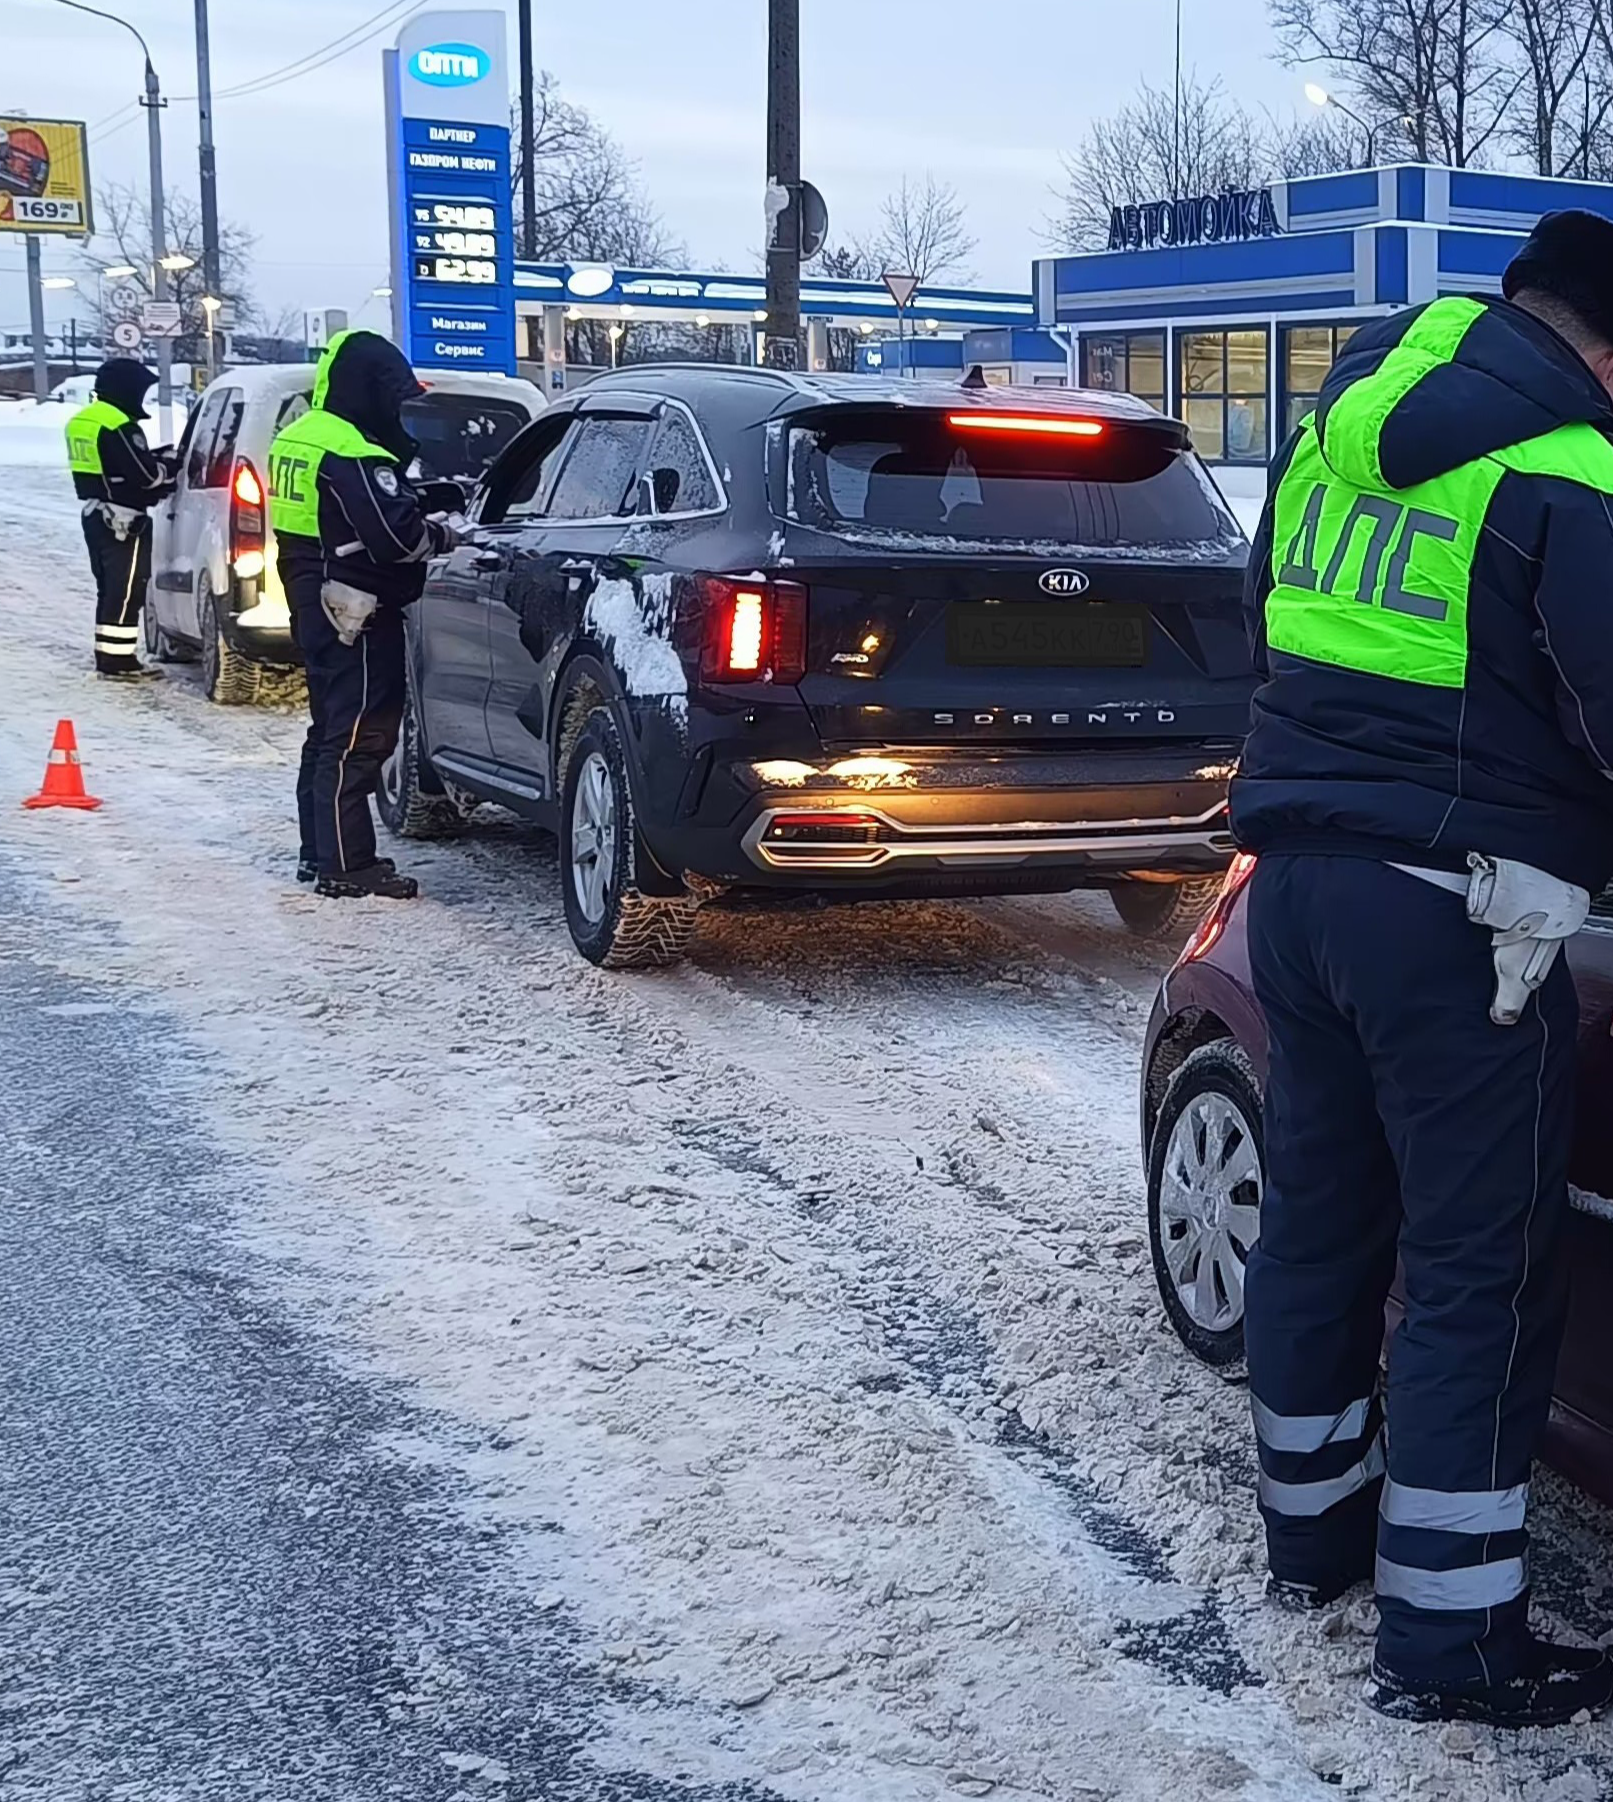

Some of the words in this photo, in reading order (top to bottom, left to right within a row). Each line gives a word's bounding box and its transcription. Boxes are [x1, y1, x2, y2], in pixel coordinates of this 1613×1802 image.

[418, 50, 479, 78] ОПТИ
[429, 126, 476, 143] ПАРТНЕР
[409, 153, 458, 169] ГАЗПРОМ
[461, 157, 496, 171] НЕФТИ
[19, 201, 58, 218] 169
[1107, 184, 1281, 252] АВТОМОЙКА
[416, 236, 431, 248] 92
[431, 317, 487, 331] Магазин
[123, 329, 133, 342] 5
[435, 342, 485, 358] Сервис
[1279, 482, 1459, 622] ДПС
[1048, 574, 1083, 591] KIA
[933, 709, 1175, 726] SORENTO
